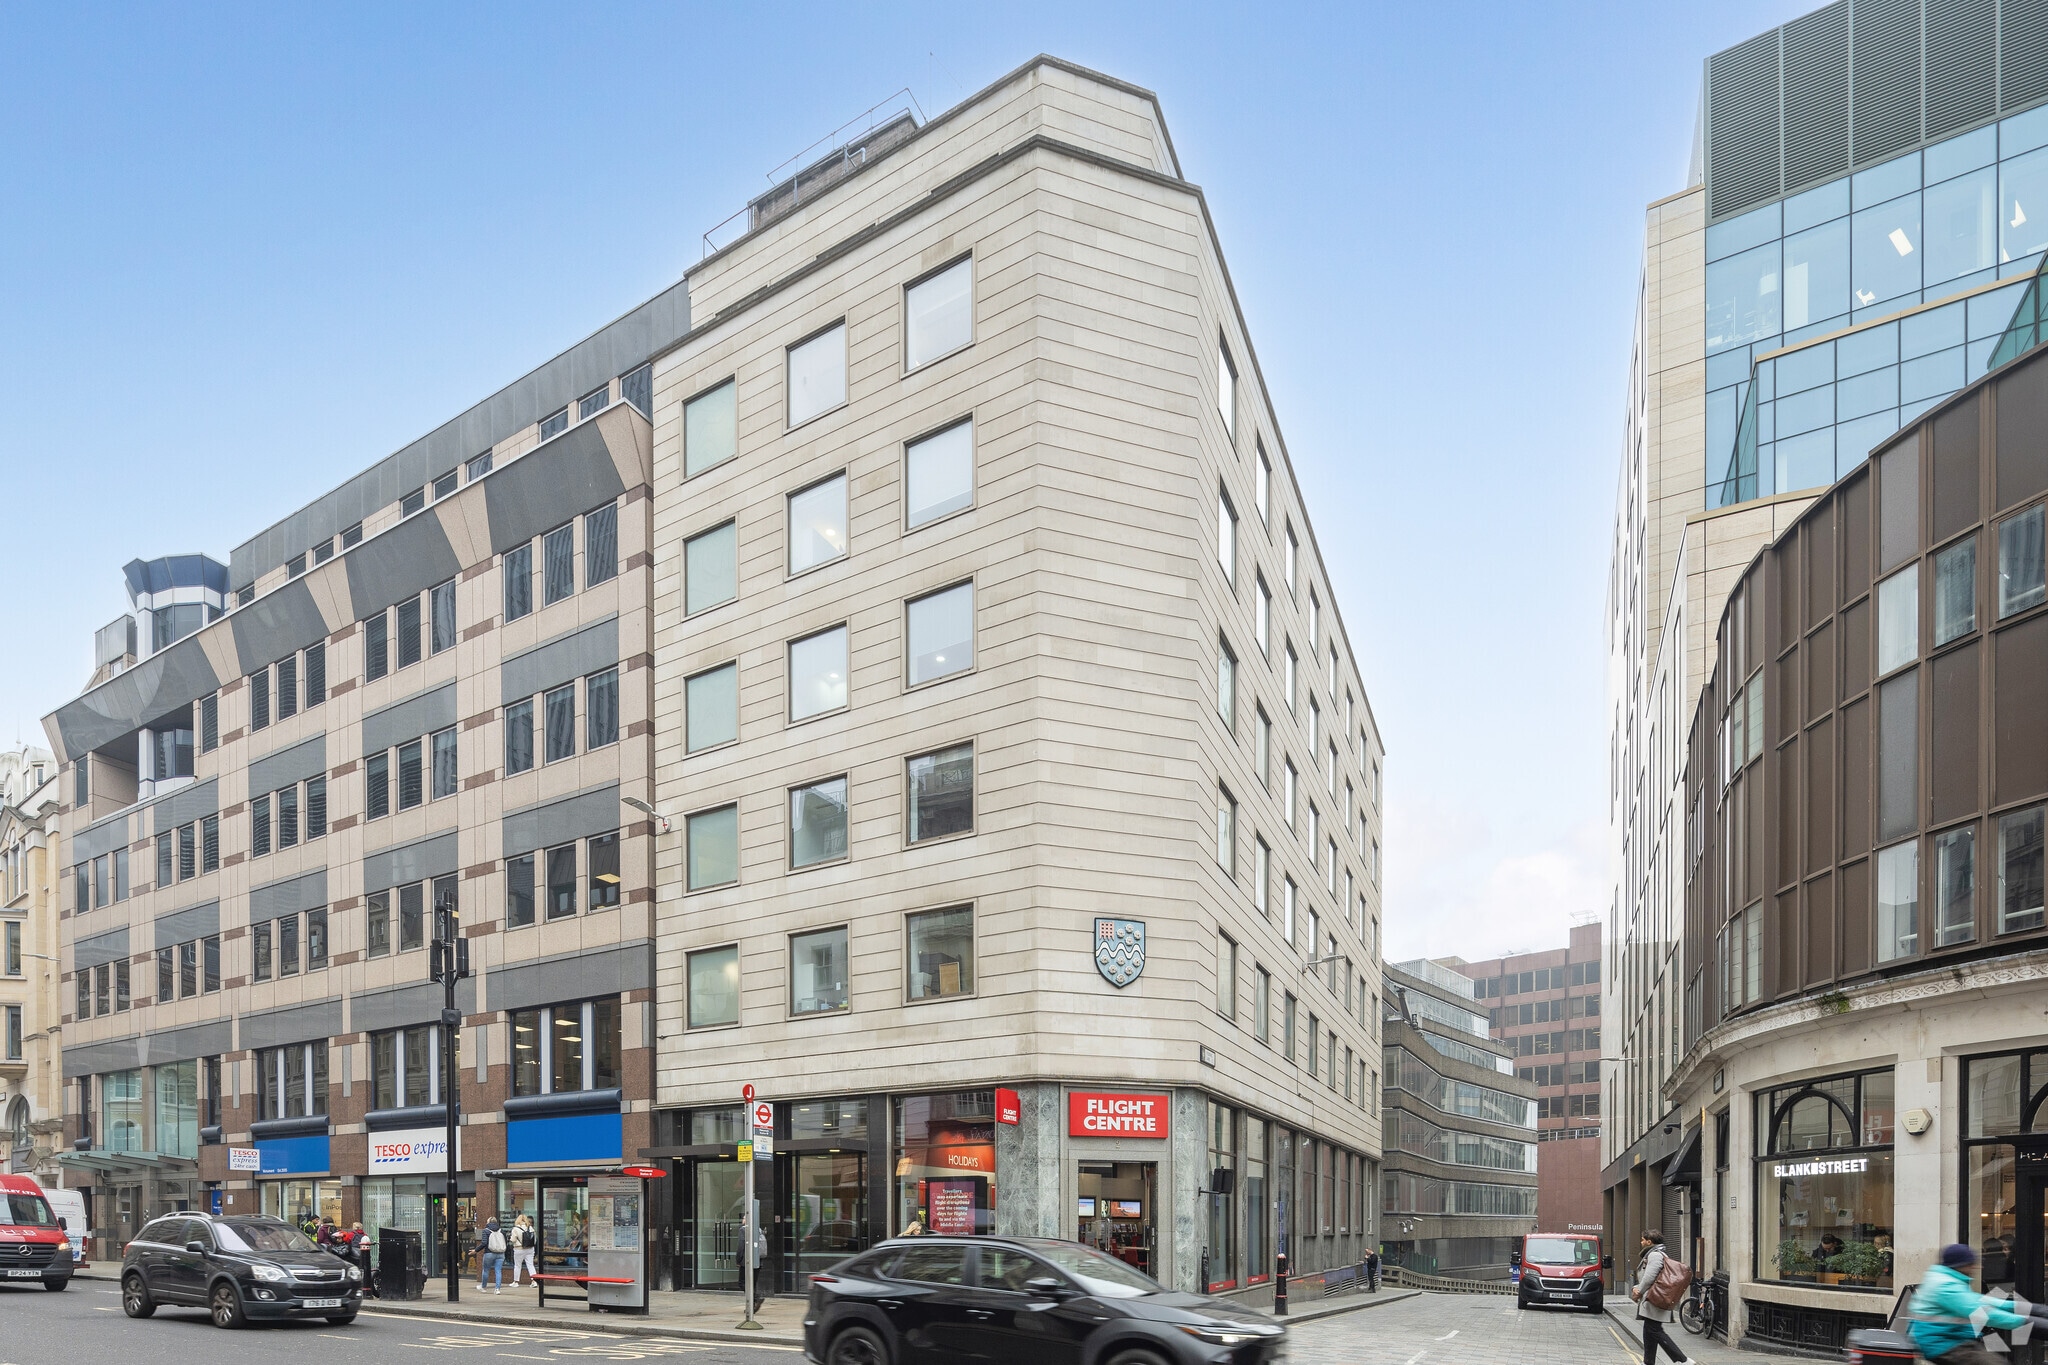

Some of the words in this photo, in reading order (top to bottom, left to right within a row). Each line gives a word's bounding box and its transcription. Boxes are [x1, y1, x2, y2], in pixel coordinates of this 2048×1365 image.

[745, 1086, 753, 1099] J
[1003, 1108, 1017, 1116] FLIGHT
[1087, 1099, 1155, 1115] FLIGHT
[1002, 1114, 1017, 1122] CENTRE
[1083, 1116, 1156, 1132] CENTRE
[374, 1143, 411, 1157] TESCO
[413, 1141, 449, 1159] expre
[948, 1155, 979, 1168] HOLIDAYS
[1774, 1162, 1812, 1178] BLANK
[1818, 1158, 1868, 1175] STREET
[1568, 1223, 1604, 1231] Peninsula
